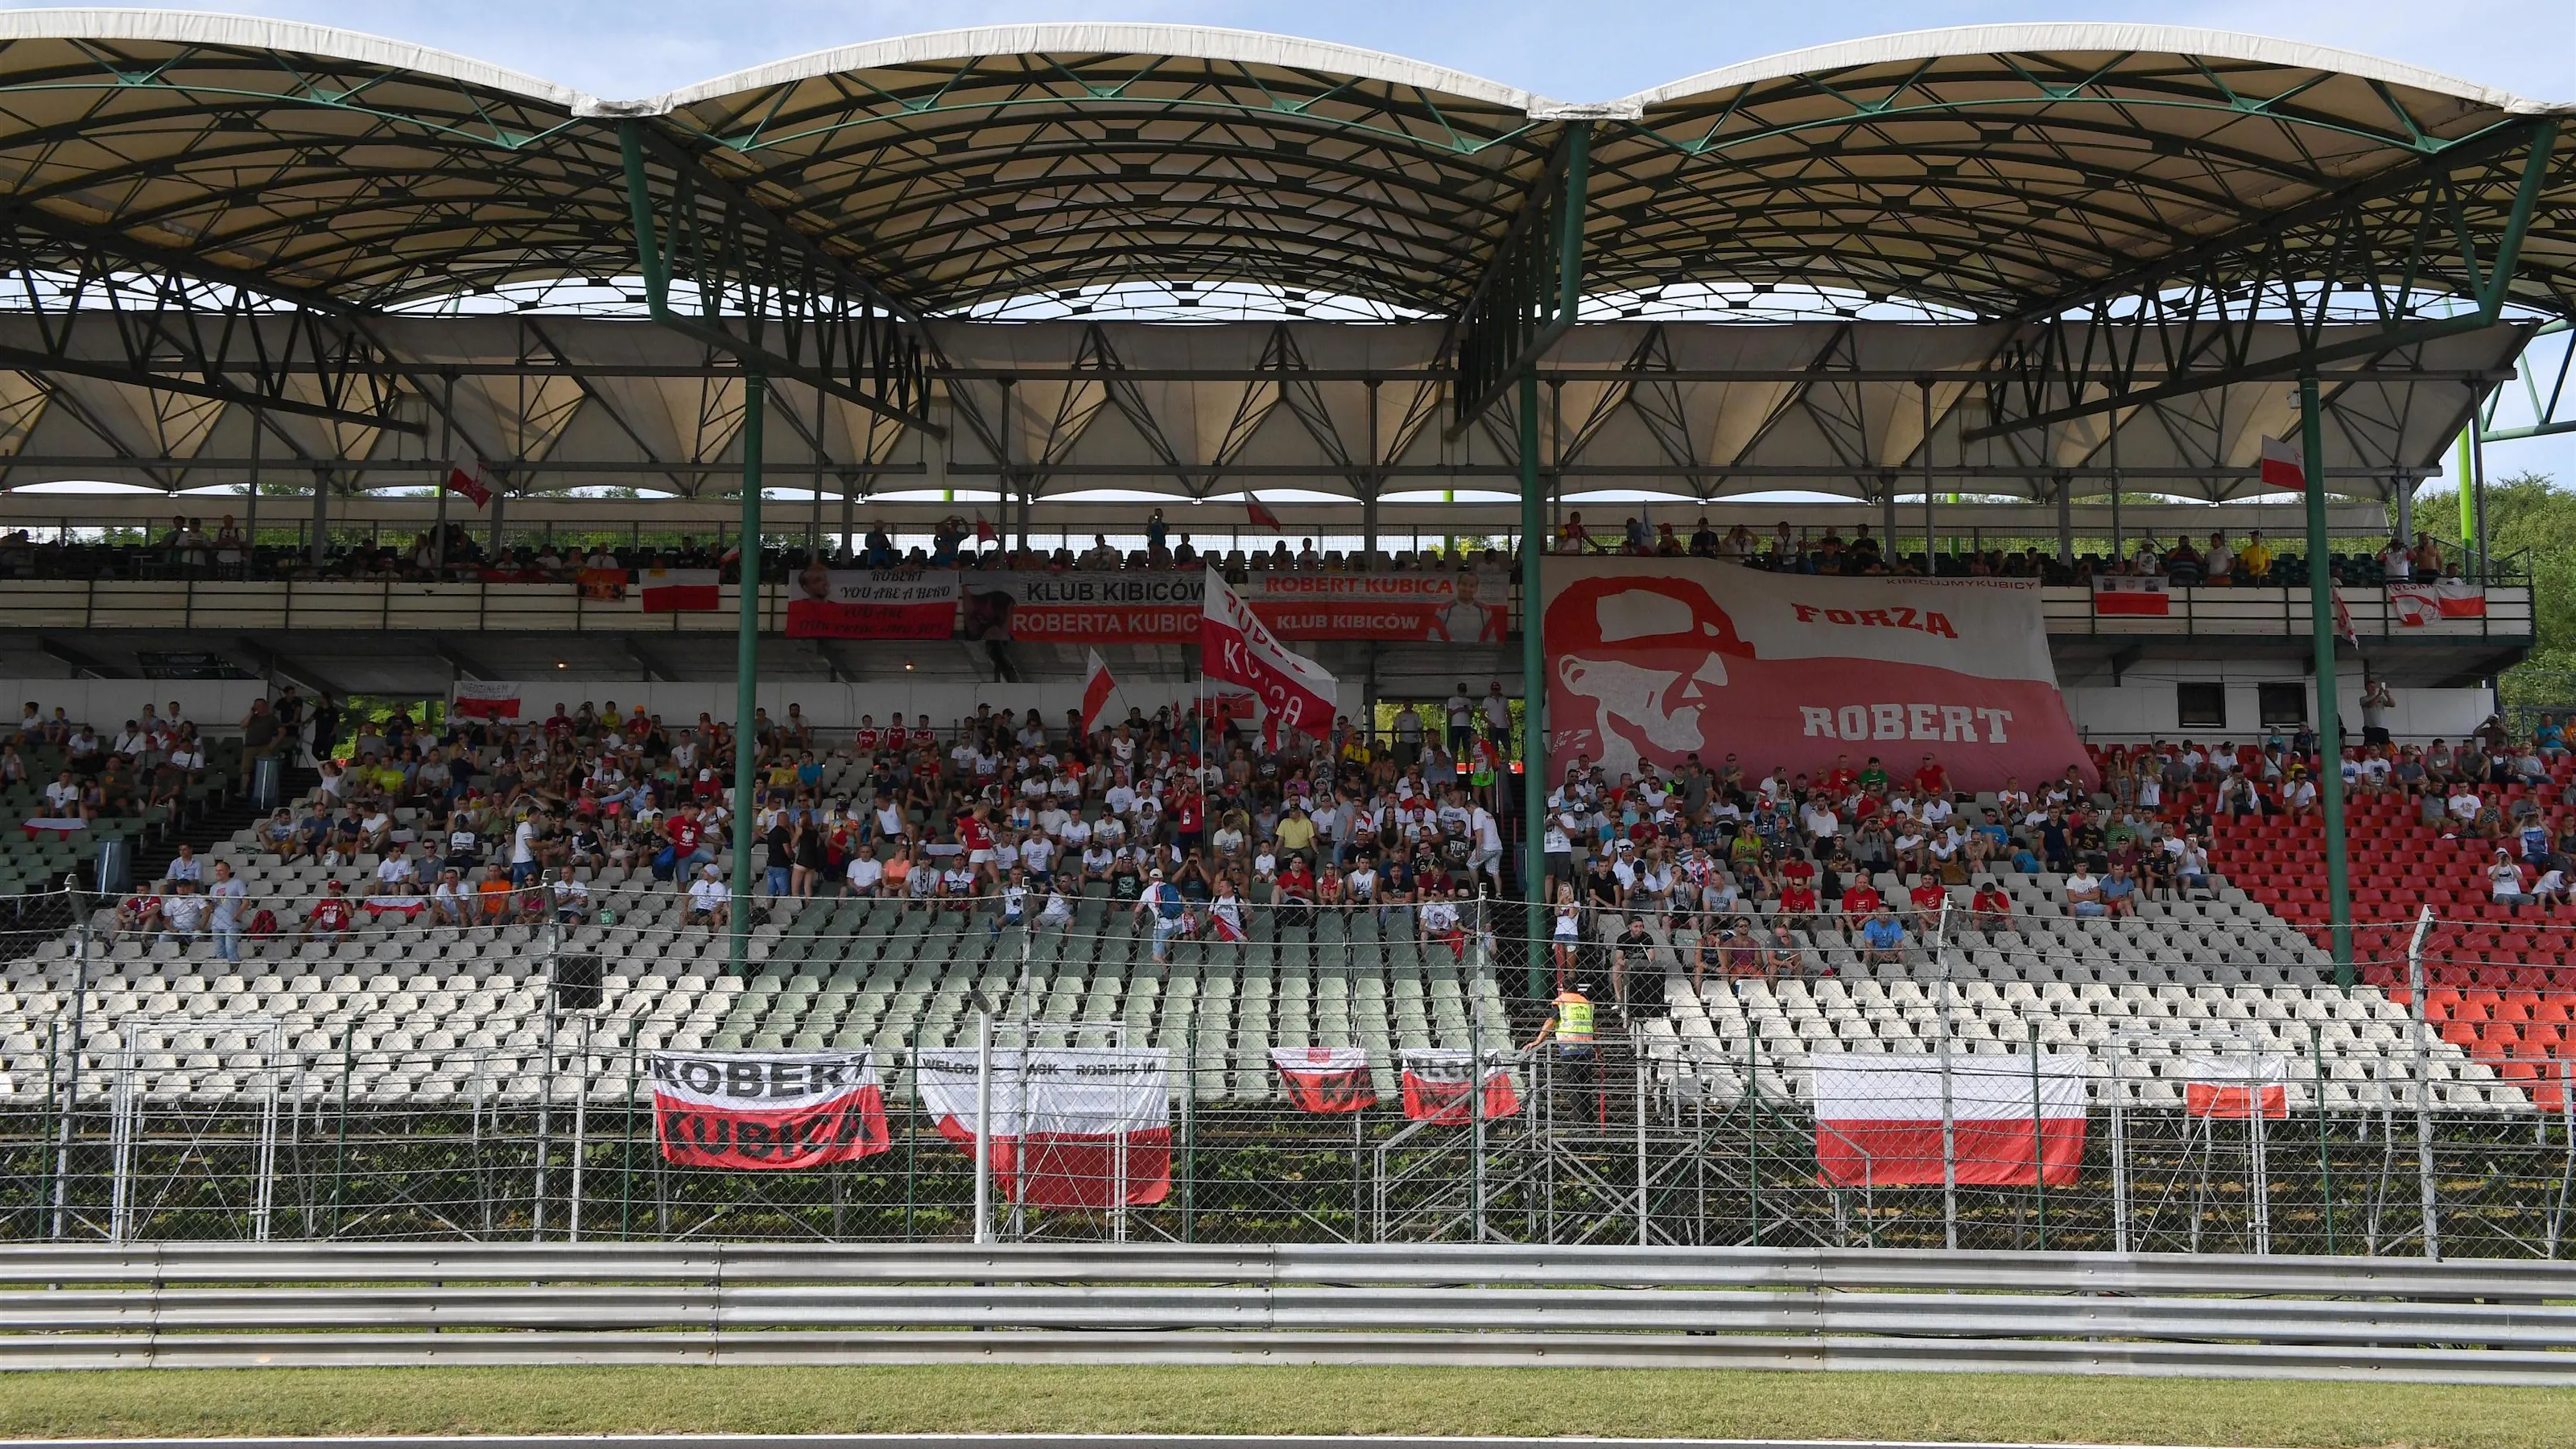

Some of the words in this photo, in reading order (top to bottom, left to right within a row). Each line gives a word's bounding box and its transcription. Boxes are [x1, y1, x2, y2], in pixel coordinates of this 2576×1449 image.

[871, 570, 925, 582] ROBERT
[1266, 576, 1357, 593] ROBERT
[1365, 577, 1453, 594] KUBICA
[840, 587, 872, 599] YOU
[873, 587, 900, 600] ARE
[903, 587, 913, 599] A
[916, 586, 951, 599] HERO
[1027, 582, 1094, 601] KLUB
[1104, 579, 1203, 601] KIBICÓW
[1012, 613, 1122, 632] ROBERTA
[1277, 614, 1327, 630] KLUB
[1333, 613, 1420, 630] KIBICÓW
[1790, 602, 1959, 639] FORZA
[1799, 703, 2013, 744] ROBERT
[653, 1051, 869, 1098] ROBERT
[1020, 1063, 1059, 1076] ACK
[666, 1104, 873, 1158] KUBICA
